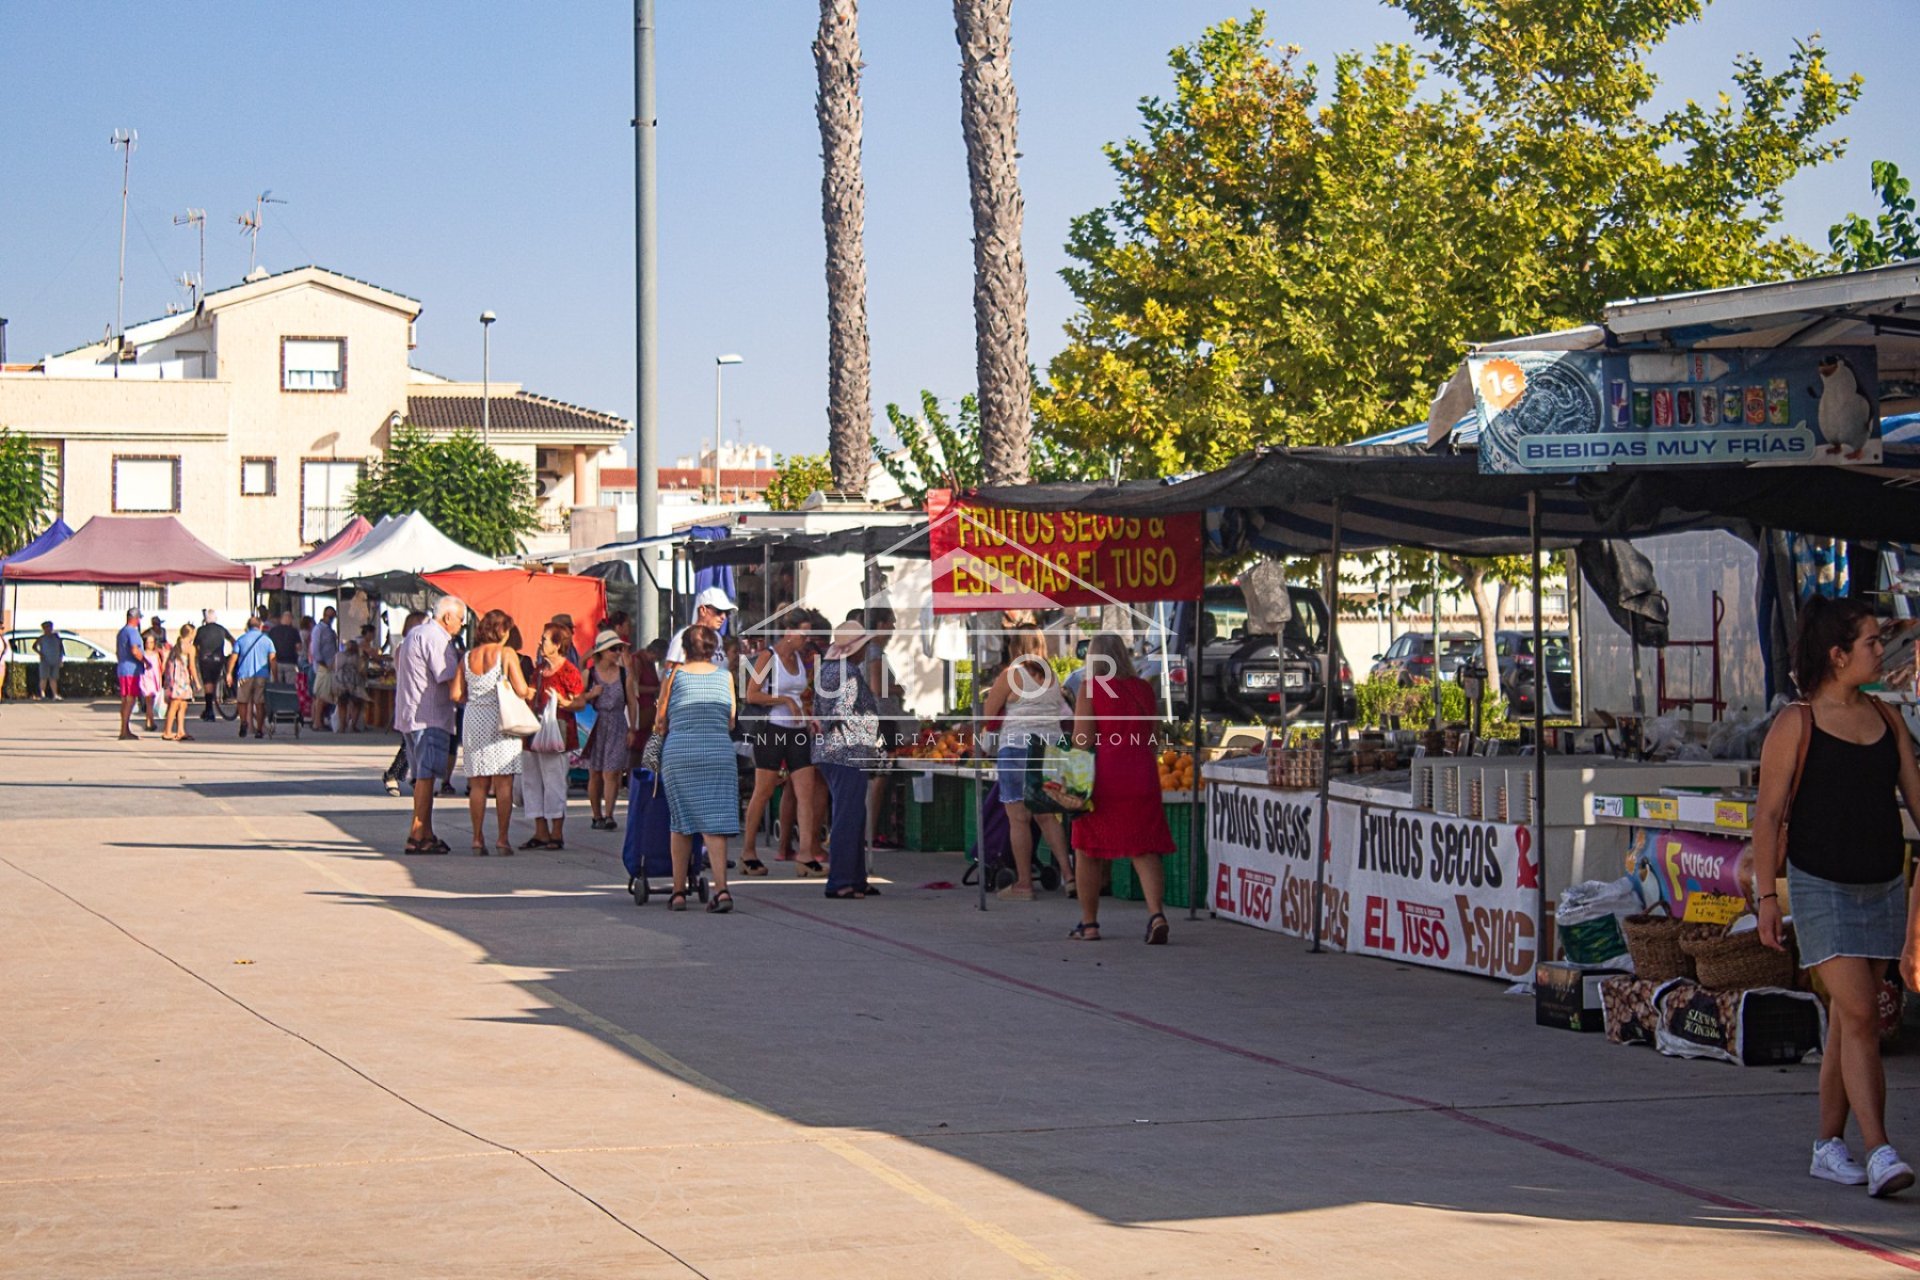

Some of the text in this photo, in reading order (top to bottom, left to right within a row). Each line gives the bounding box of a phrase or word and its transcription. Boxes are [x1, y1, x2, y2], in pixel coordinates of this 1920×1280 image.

[1488, 371, 1517, 397] 1€
[1526, 433, 1805, 460] BEBIDAS MUY FRÍAS
[958, 507, 1055, 548] FRUTOS
[1060, 511, 1141, 543] SECOS
[953, 547, 1177, 598] ESPECIAS EL TUSO
[1212, 783, 1261, 851] Frutos
[1263, 799, 1311, 861] secos
[1358, 805, 1539, 889] Frutos secos &
[1215, 862, 1237, 914] EL
[1666, 841, 1724, 902] Frutos
[1364, 895, 1396, 951] EL
